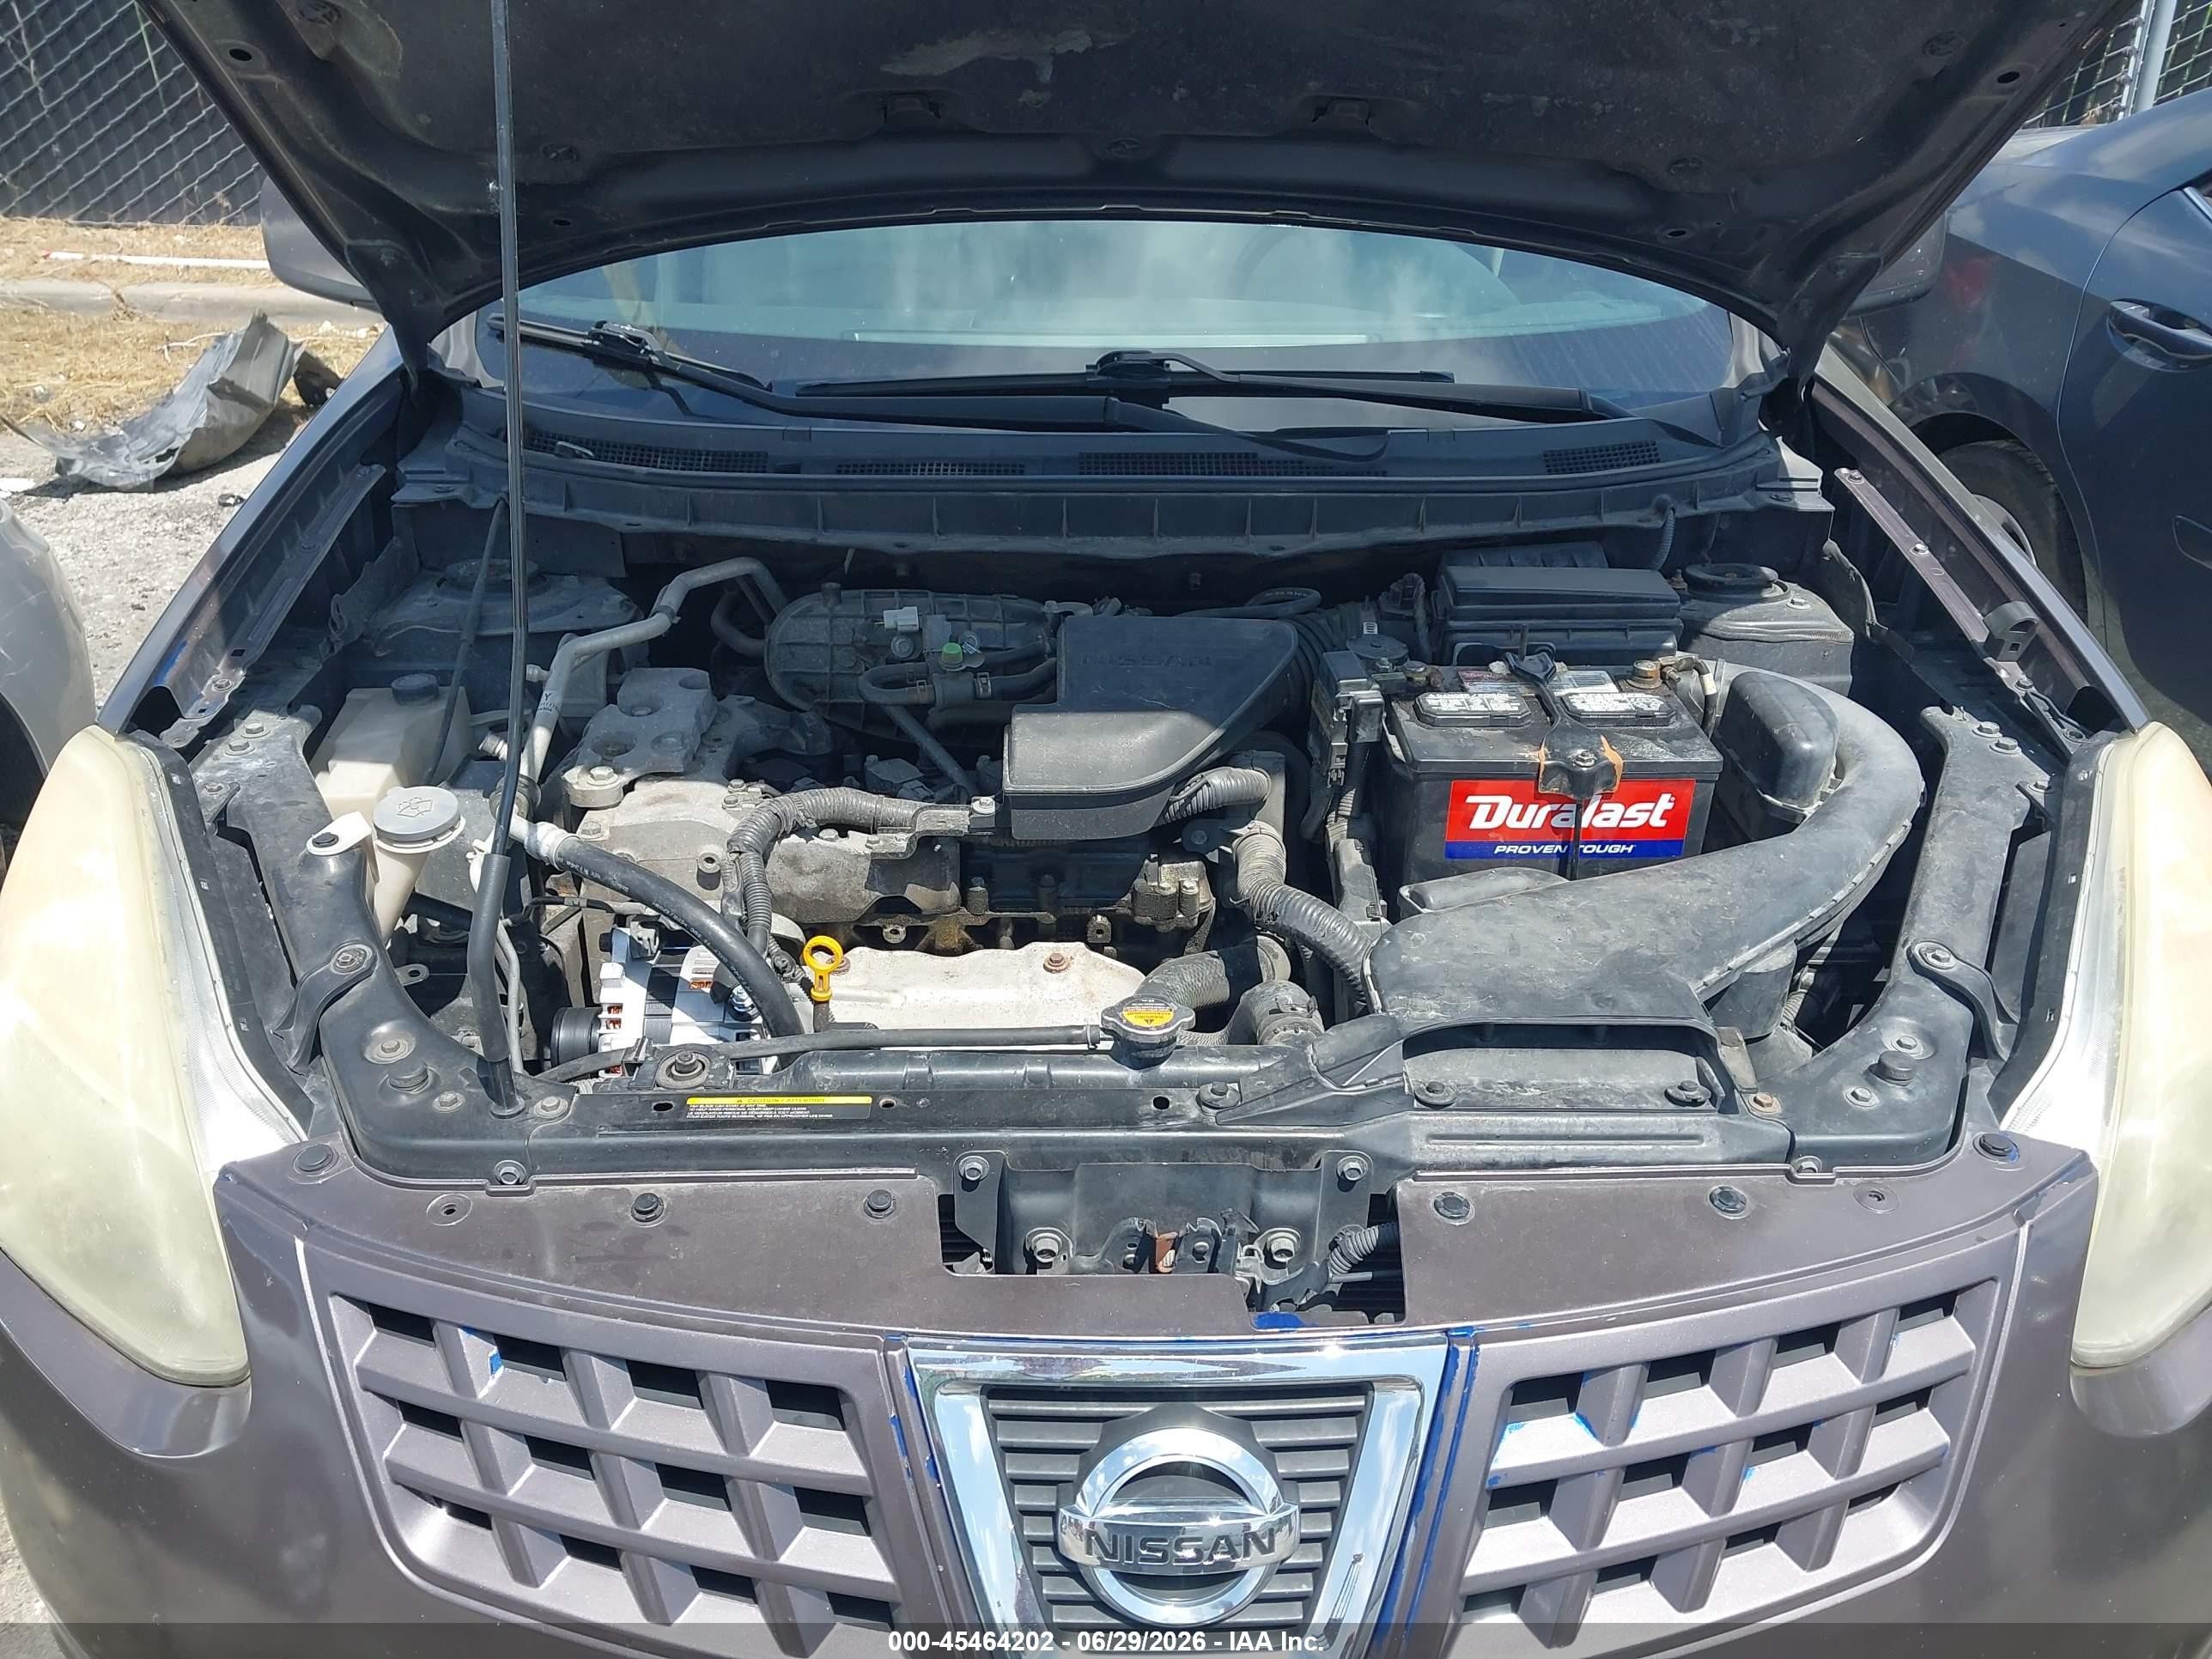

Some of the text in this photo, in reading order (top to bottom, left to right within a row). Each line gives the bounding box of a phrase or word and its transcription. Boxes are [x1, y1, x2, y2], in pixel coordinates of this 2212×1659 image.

[1465, 793, 1675, 830] Duralast
[1494, 844, 1568, 854] PROVEN
[1085, 1528, 1278, 1566] NISSAN
